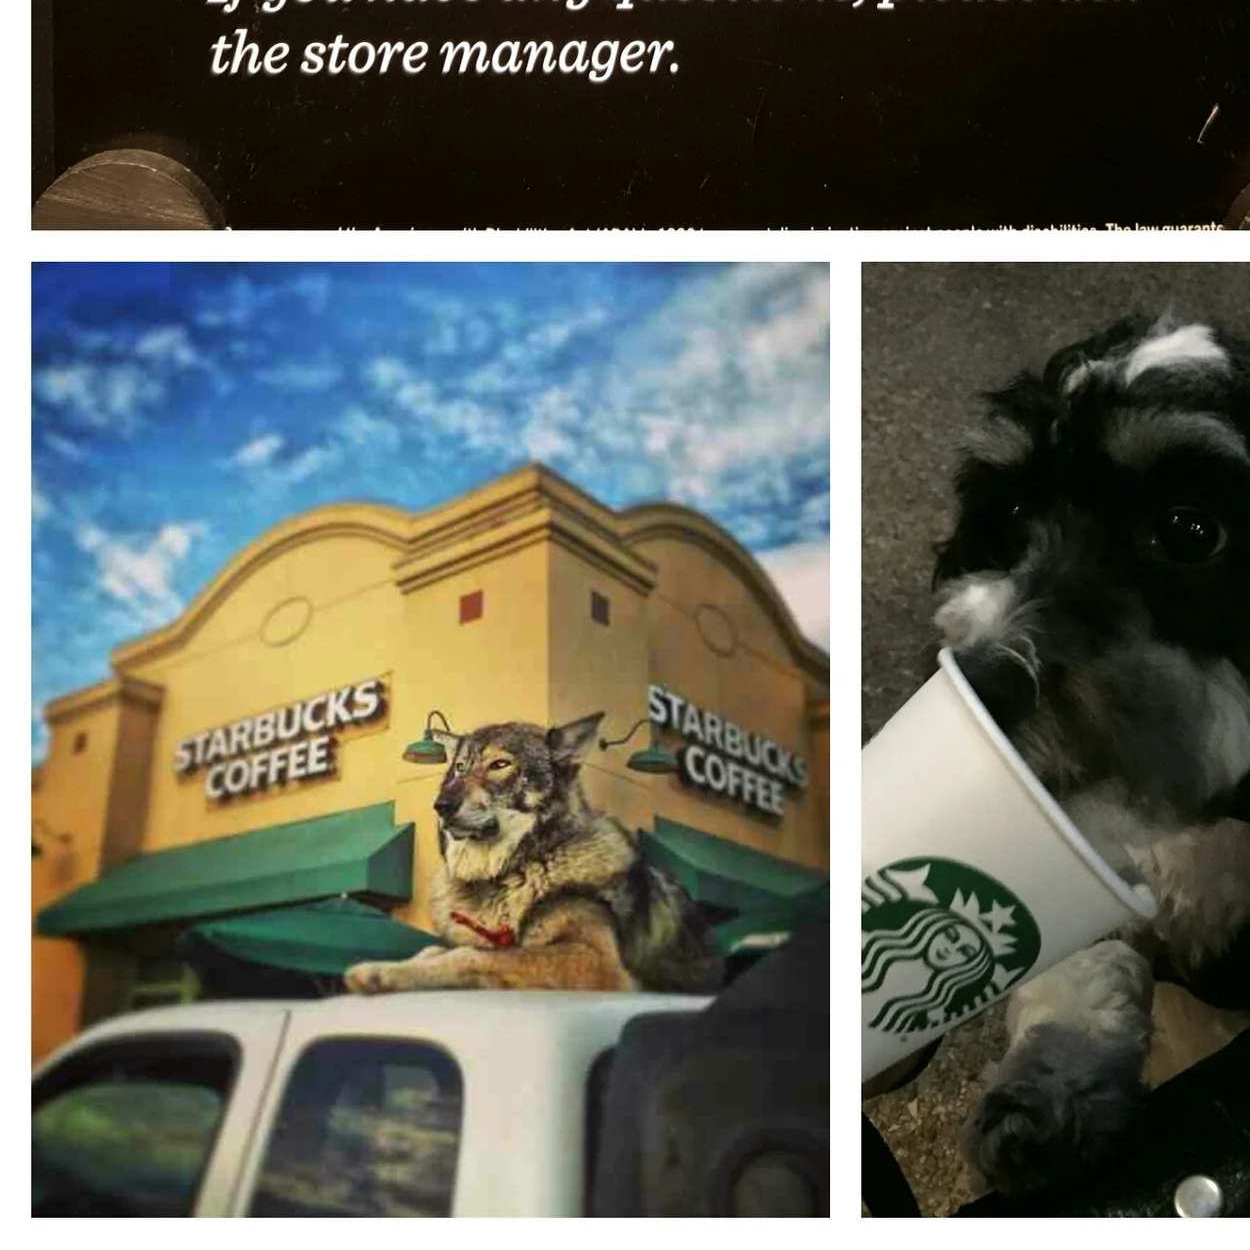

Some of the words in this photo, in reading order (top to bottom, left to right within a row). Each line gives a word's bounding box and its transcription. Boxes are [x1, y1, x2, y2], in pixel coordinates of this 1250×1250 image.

[211, 29, 290, 75] the
[300, 34, 429, 74] store
[439, 40, 679, 83] manager.
[172, 679, 381, 772] STARBUCKS
[647, 683, 808, 789] STARBUCKS
[204, 735, 331, 798] COFFEE
[684, 743, 785, 816] COFFEE
